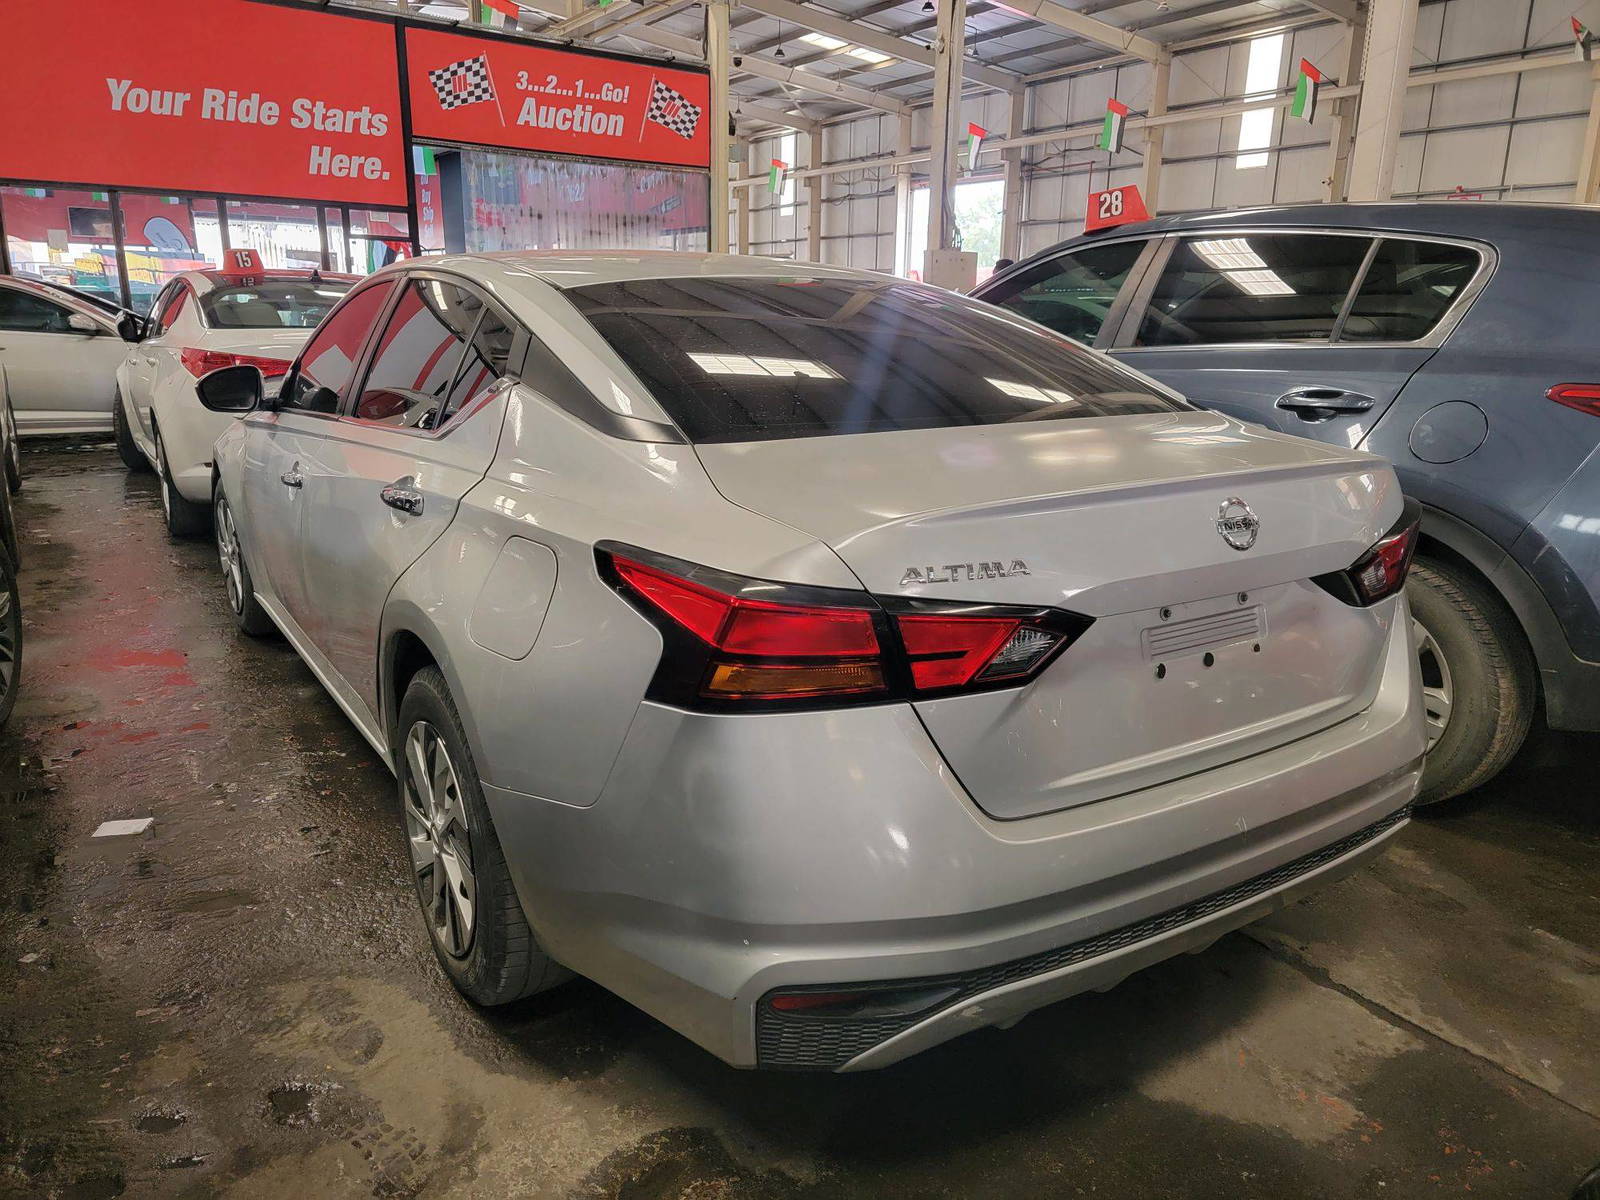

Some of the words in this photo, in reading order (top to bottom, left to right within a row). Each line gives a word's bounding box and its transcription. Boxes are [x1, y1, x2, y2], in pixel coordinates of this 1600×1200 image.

[515, 70, 630, 104] 3...2...1...Go!
[106, 78, 191, 116] Your
[201, 87, 280, 125] Ride
[290, 98, 388, 136] Starts
[516, 97, 625, 136] Auction
[308, 145, 390, 180] Here.
[1099, 190, 1123, 219] 28
[235, 251, 252, 268] 15
[899, 559, 1031, 585] ALTIMA
